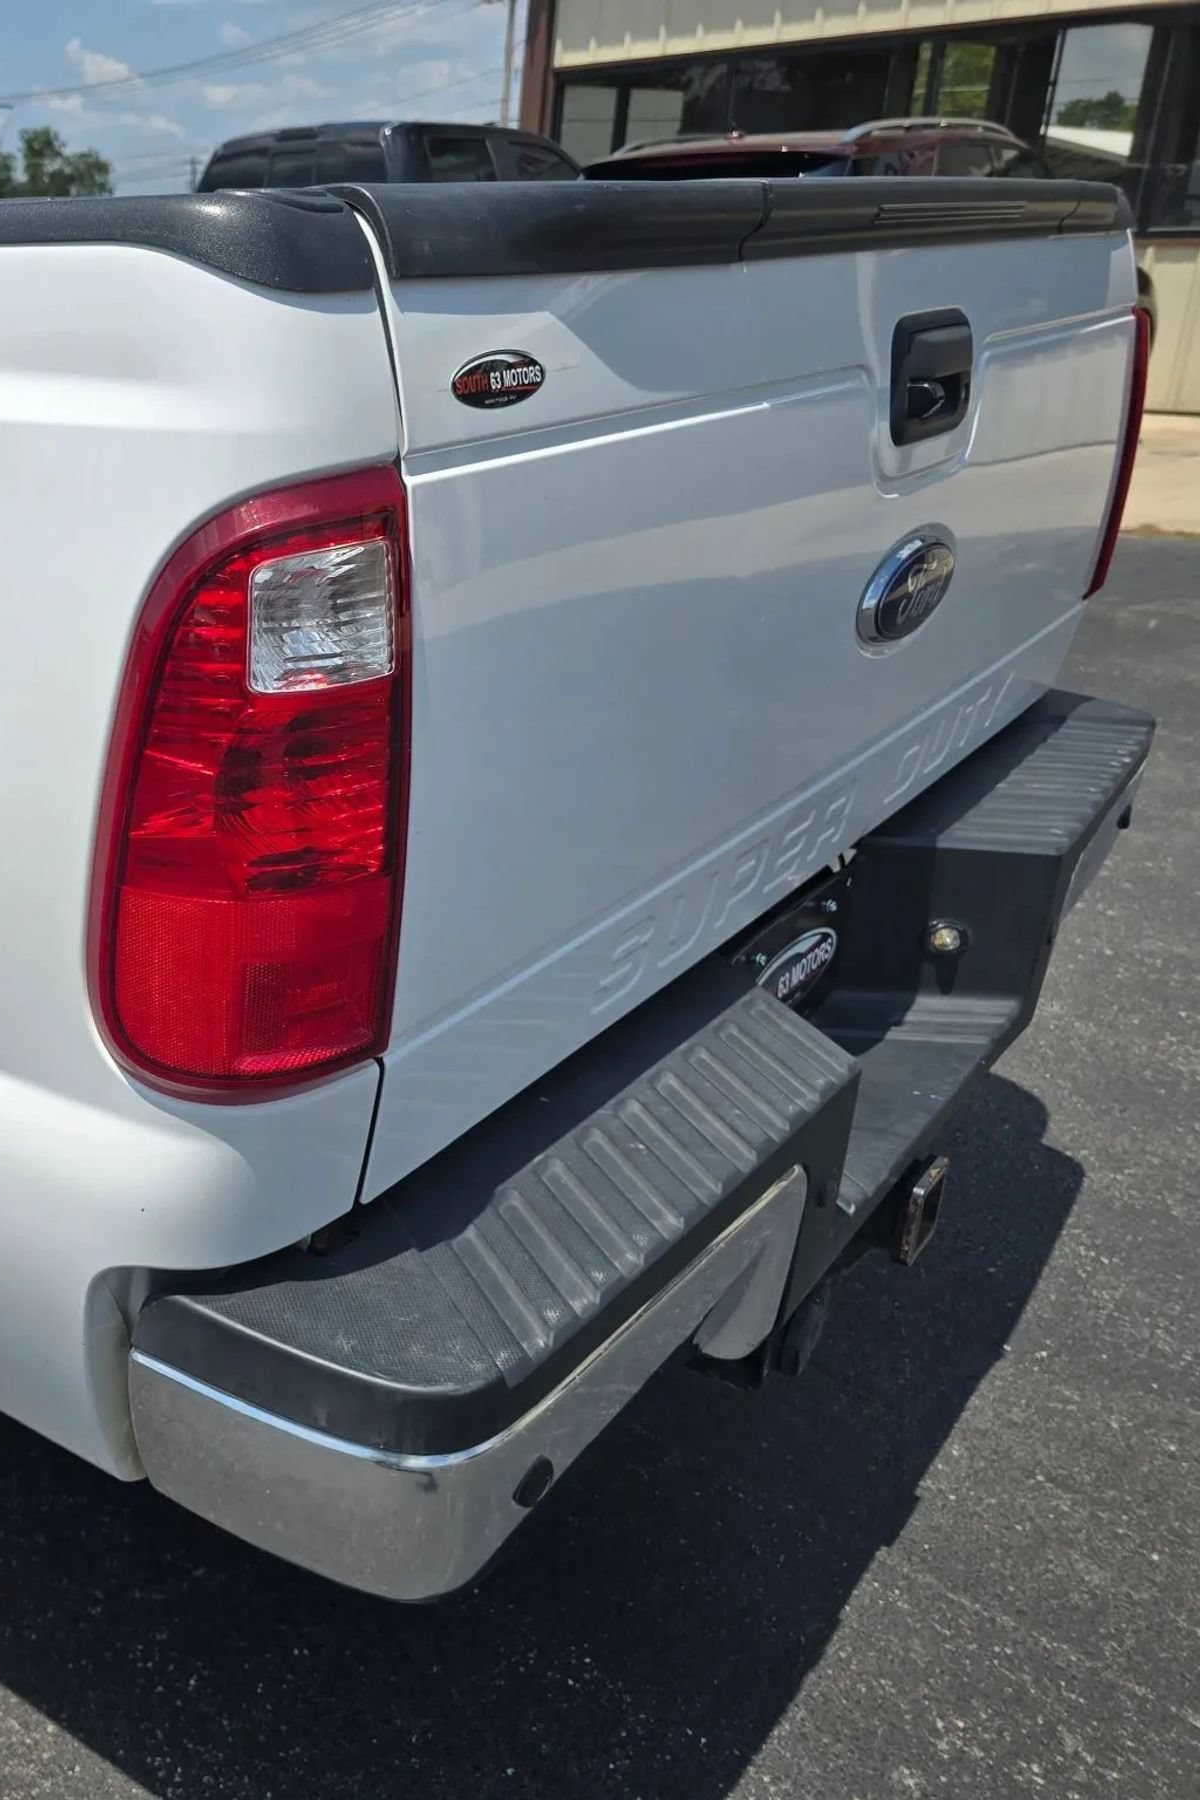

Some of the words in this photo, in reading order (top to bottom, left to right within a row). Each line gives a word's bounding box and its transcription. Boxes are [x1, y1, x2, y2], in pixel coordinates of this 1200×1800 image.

[455, 373, 489, 395] SOUTH
[490, 371, 502, 390] 63
[503, 365, 542, 387] MOTORS
[590, 777, 858, 1016] SUPER
[777, 972, 791, 998] 63
[790, 937, 832, 988] MOTORS
